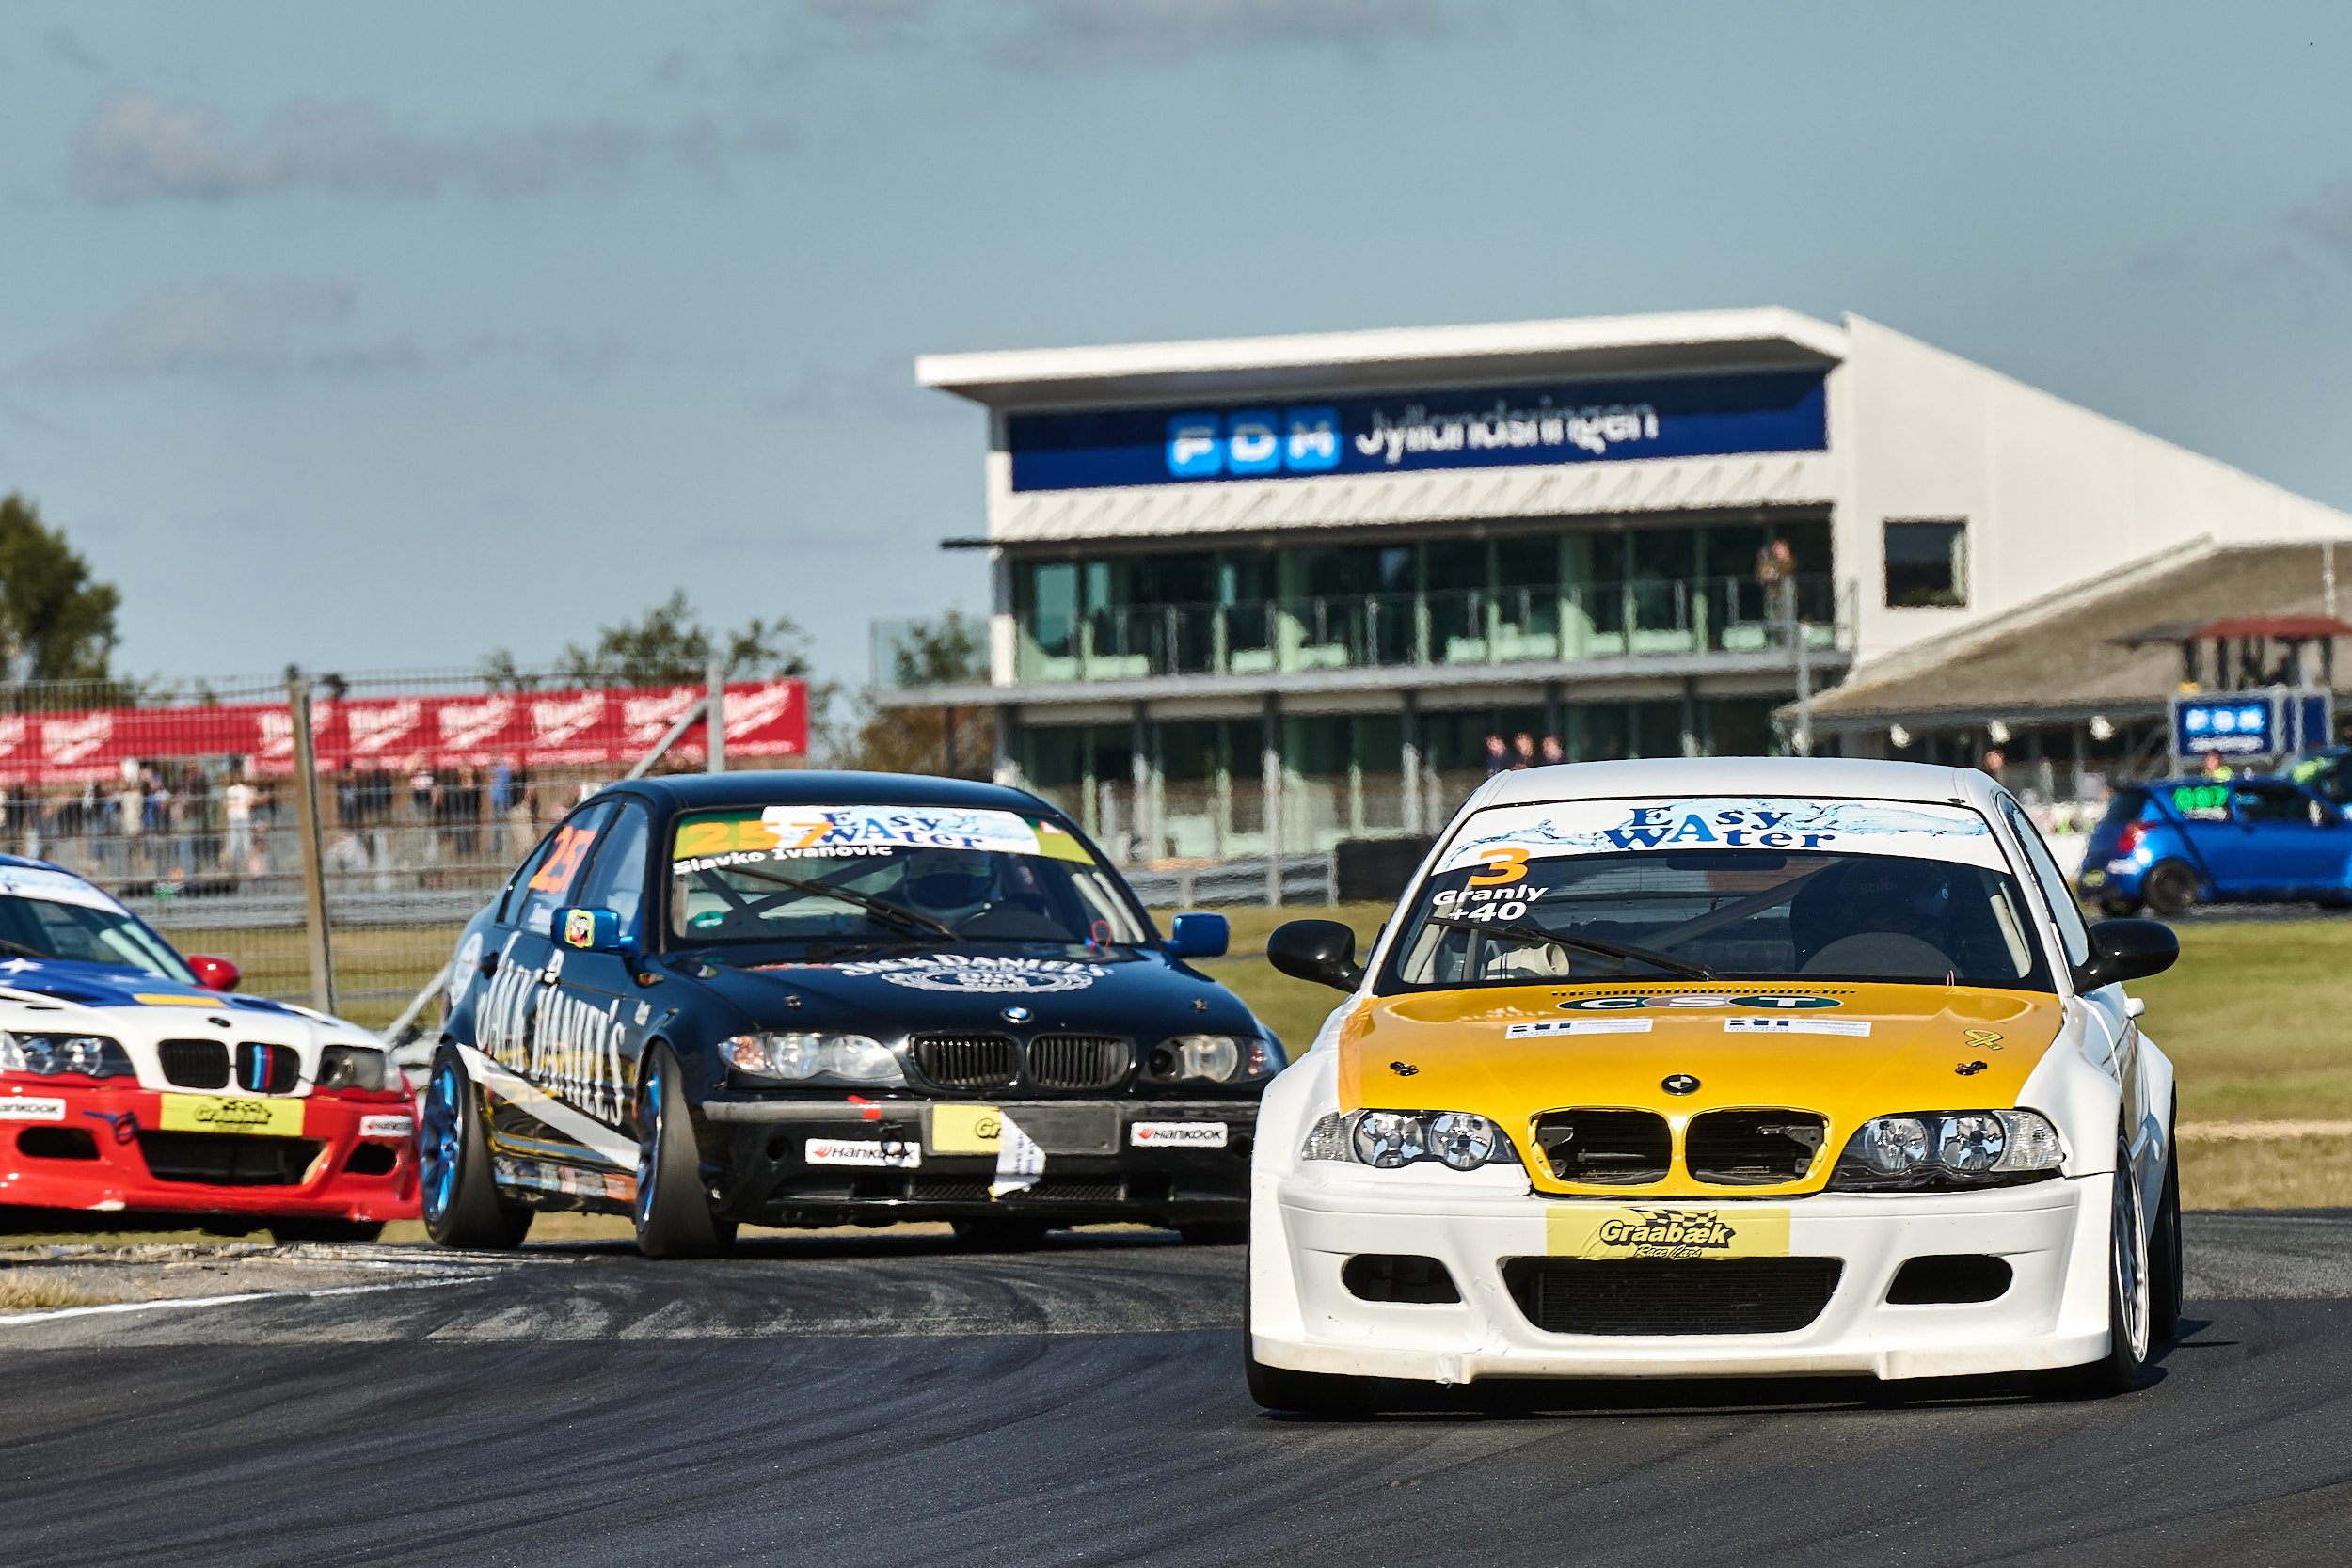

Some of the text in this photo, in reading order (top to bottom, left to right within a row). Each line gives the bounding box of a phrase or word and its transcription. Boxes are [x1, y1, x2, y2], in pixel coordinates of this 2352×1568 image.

[1172, 397, 1660, 465] FDM Jyllandsringen
[686, 820, 834, 853] 257
[672, 845, 894, 875] Slavko Ivanovic
[1469, 847, 1531, 886] 3
[1432, 884, 1549, 906] Granly
[1448, 901, 1528, 923] +40
[1599, 1218, 1732, 1245] Graabæk
[1634, 1243, 1703, 1260] Race Cars
